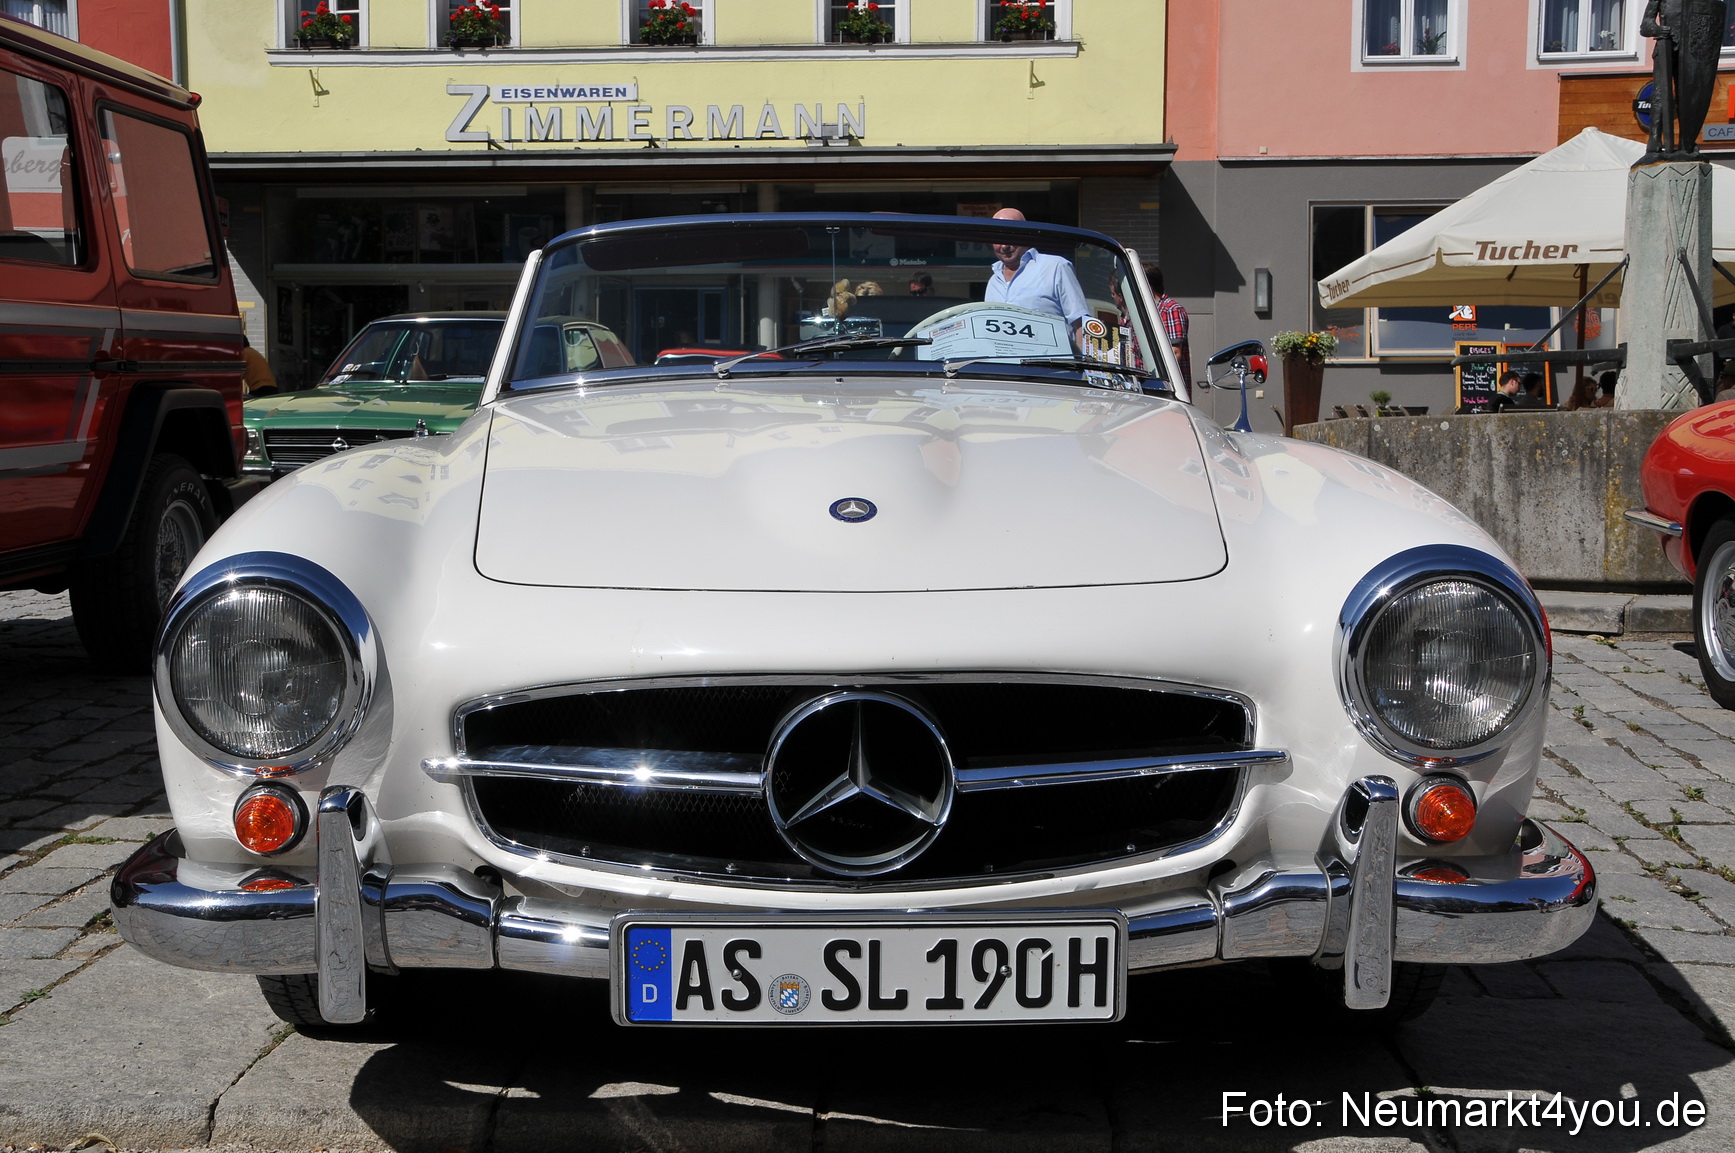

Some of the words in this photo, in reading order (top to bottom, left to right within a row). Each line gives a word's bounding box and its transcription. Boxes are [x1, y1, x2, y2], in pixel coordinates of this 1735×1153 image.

[501, 88, 627, 99] EISENWAREN
[445, 85, 866, 142] ZIMMERMANN
[1708, 127, 1735, 137] CAF
[1475, 240, 1579, 260] Tucher
[899, 258, 927, 266] Metabo
[1327, 278, 1350, 301] Tucher
[985, 319, 1036, 338] 534
[1452, 323, 1478, 331] PEPE
[675, 939, 762, 1011] AS
[822, 938, 907, 1011] SL
[642, 984, 658, 1003] D
